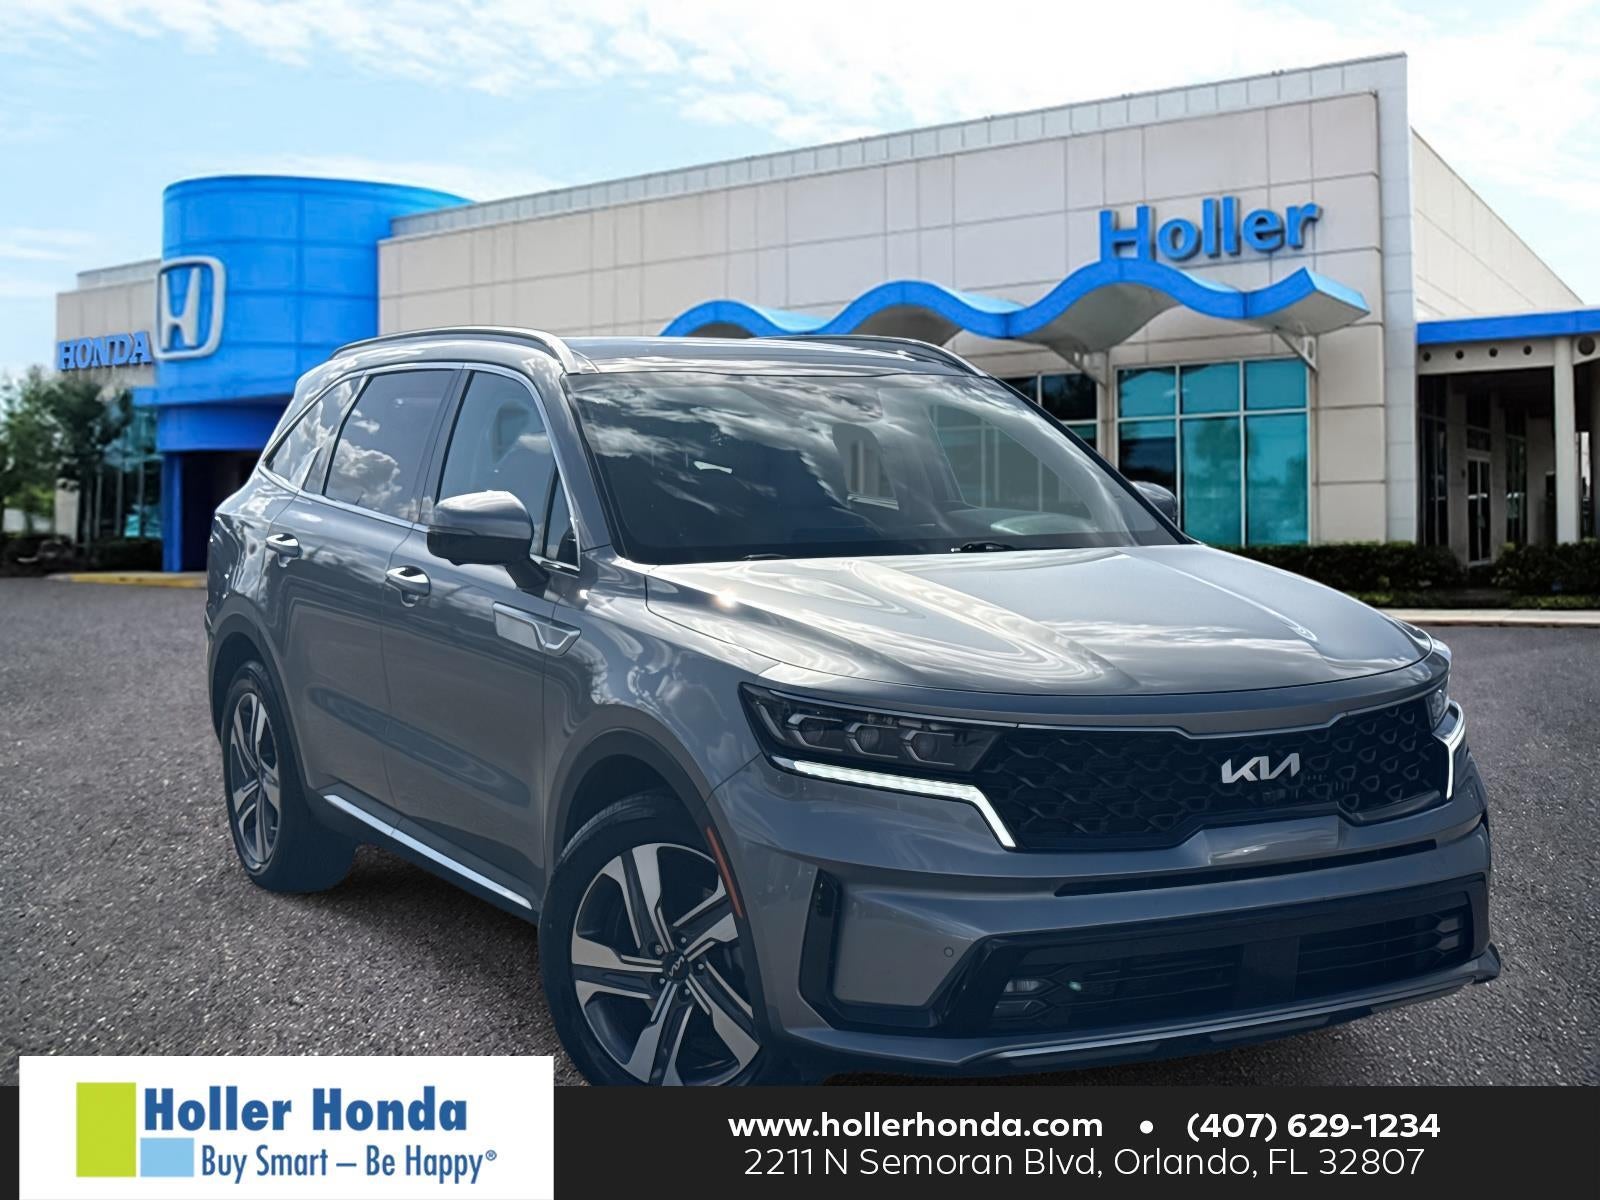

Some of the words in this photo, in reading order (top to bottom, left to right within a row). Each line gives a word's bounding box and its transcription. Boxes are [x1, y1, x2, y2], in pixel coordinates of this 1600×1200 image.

[1098, 195, 1322, 261] Holler
[57, 331, 152, 371] HONDA
[1221, 752, 1300, 784] KIA
